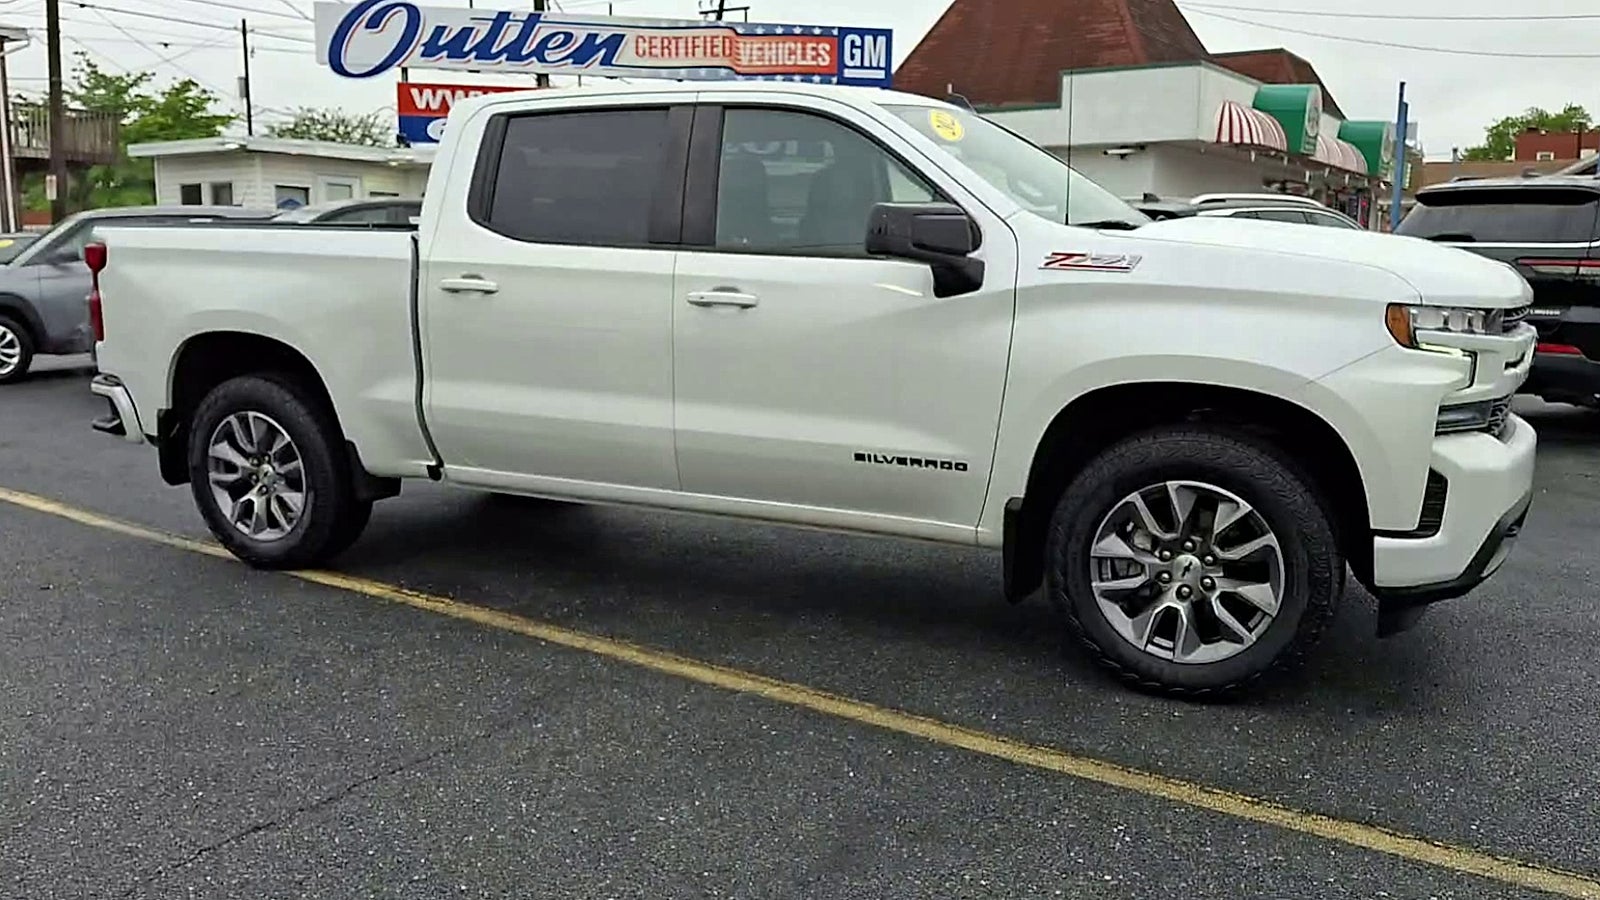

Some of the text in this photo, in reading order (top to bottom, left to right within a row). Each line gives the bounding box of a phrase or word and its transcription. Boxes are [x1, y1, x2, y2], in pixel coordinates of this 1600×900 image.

[328, 0, 626, 77] Outten
[635, 34, 831, 66] CERTIFIED VEHICLES
[844, 34, 886, 67] GM
[853, 452, 969, 472] SILVERADO
